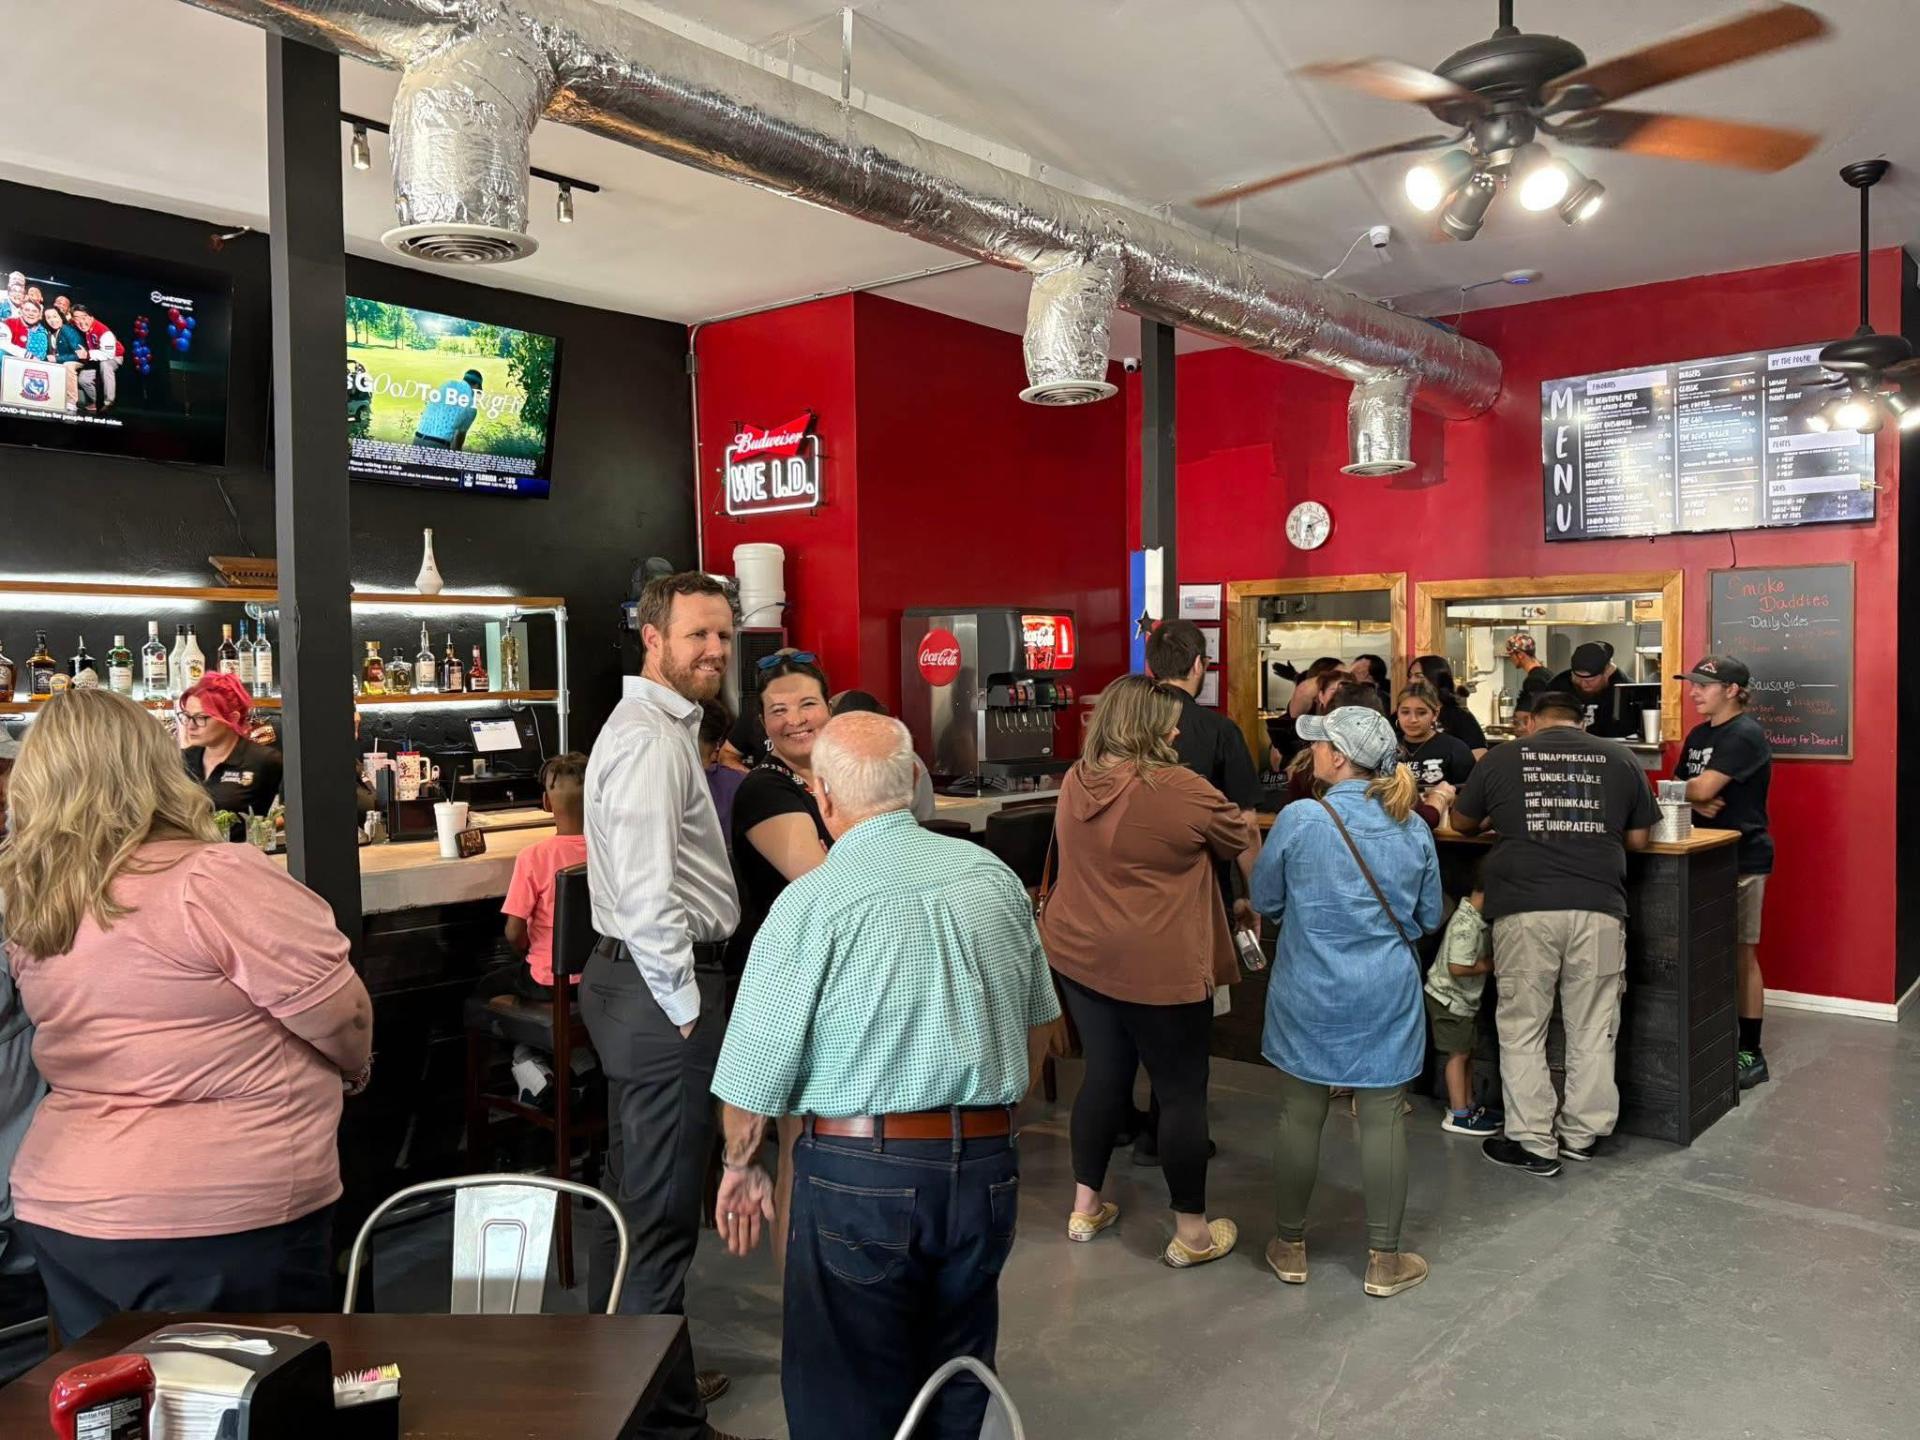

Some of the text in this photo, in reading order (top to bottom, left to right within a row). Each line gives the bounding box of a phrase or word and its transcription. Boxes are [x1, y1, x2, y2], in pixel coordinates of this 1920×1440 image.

[445, 387, 469, 407] Be
[734, 430, 803, 454] Budweiser
[731, 462, 767, 502] WE
[1725, 575, 1785, 600] Smoke
[1759, 593, 1830, 613] Daddies
[1747, 615, 1781, 631] Daily
[1748, 677, 1797, 694] Sausage
[1521, 752, 1607, 764] THE UNAPPRECIATED
[1523, 773, 1540, 783] THE
[1525, 798, 1600, 810] THE UNTHINKABLE
[1527, 820, 1607, 833] THE UNGRATEFUL
